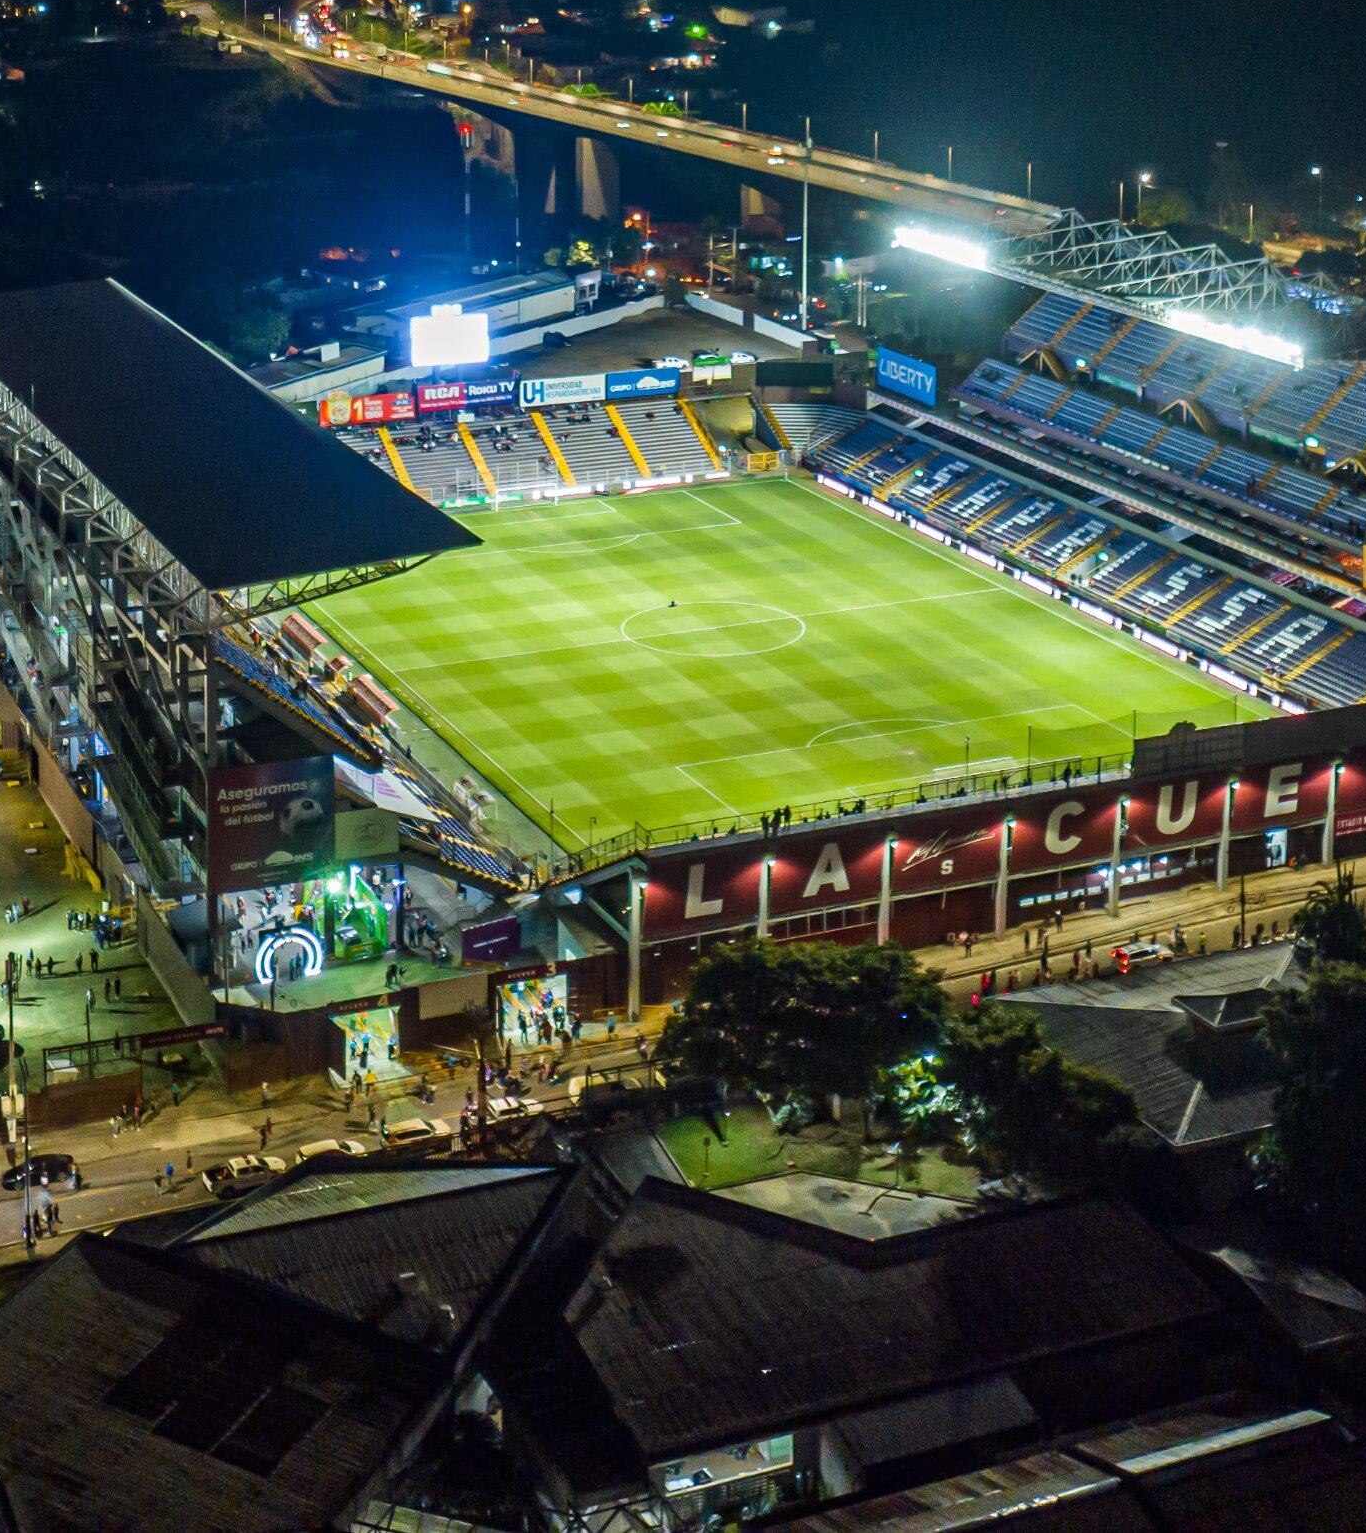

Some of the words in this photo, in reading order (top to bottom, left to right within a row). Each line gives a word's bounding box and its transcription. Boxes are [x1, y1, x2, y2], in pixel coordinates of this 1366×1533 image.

[879, 358, 933, 394] LIBERTY
[424, 386, 459, 400] RCA
[498, 381, 515, 393] TV
[522, 381, 545, 404] UH
[545, 380, 582, 392] UNIVERSIDAD
[545, 386, 601, 398] HISPANOAMERICANA
[217, 780, 307, 801] Aseguramos
[219, 804, 229, 814] la
[232, 801, 267, 814] pasión
[224, 815, 241, 826] del
[243, 812, 274, 824] fútbol
[230, 861, 258, 872] GRUPO
[294, 852, 314, 863] INS
[546, 961, 556, 977] 3
[376, 993, 389, 1007] 4
